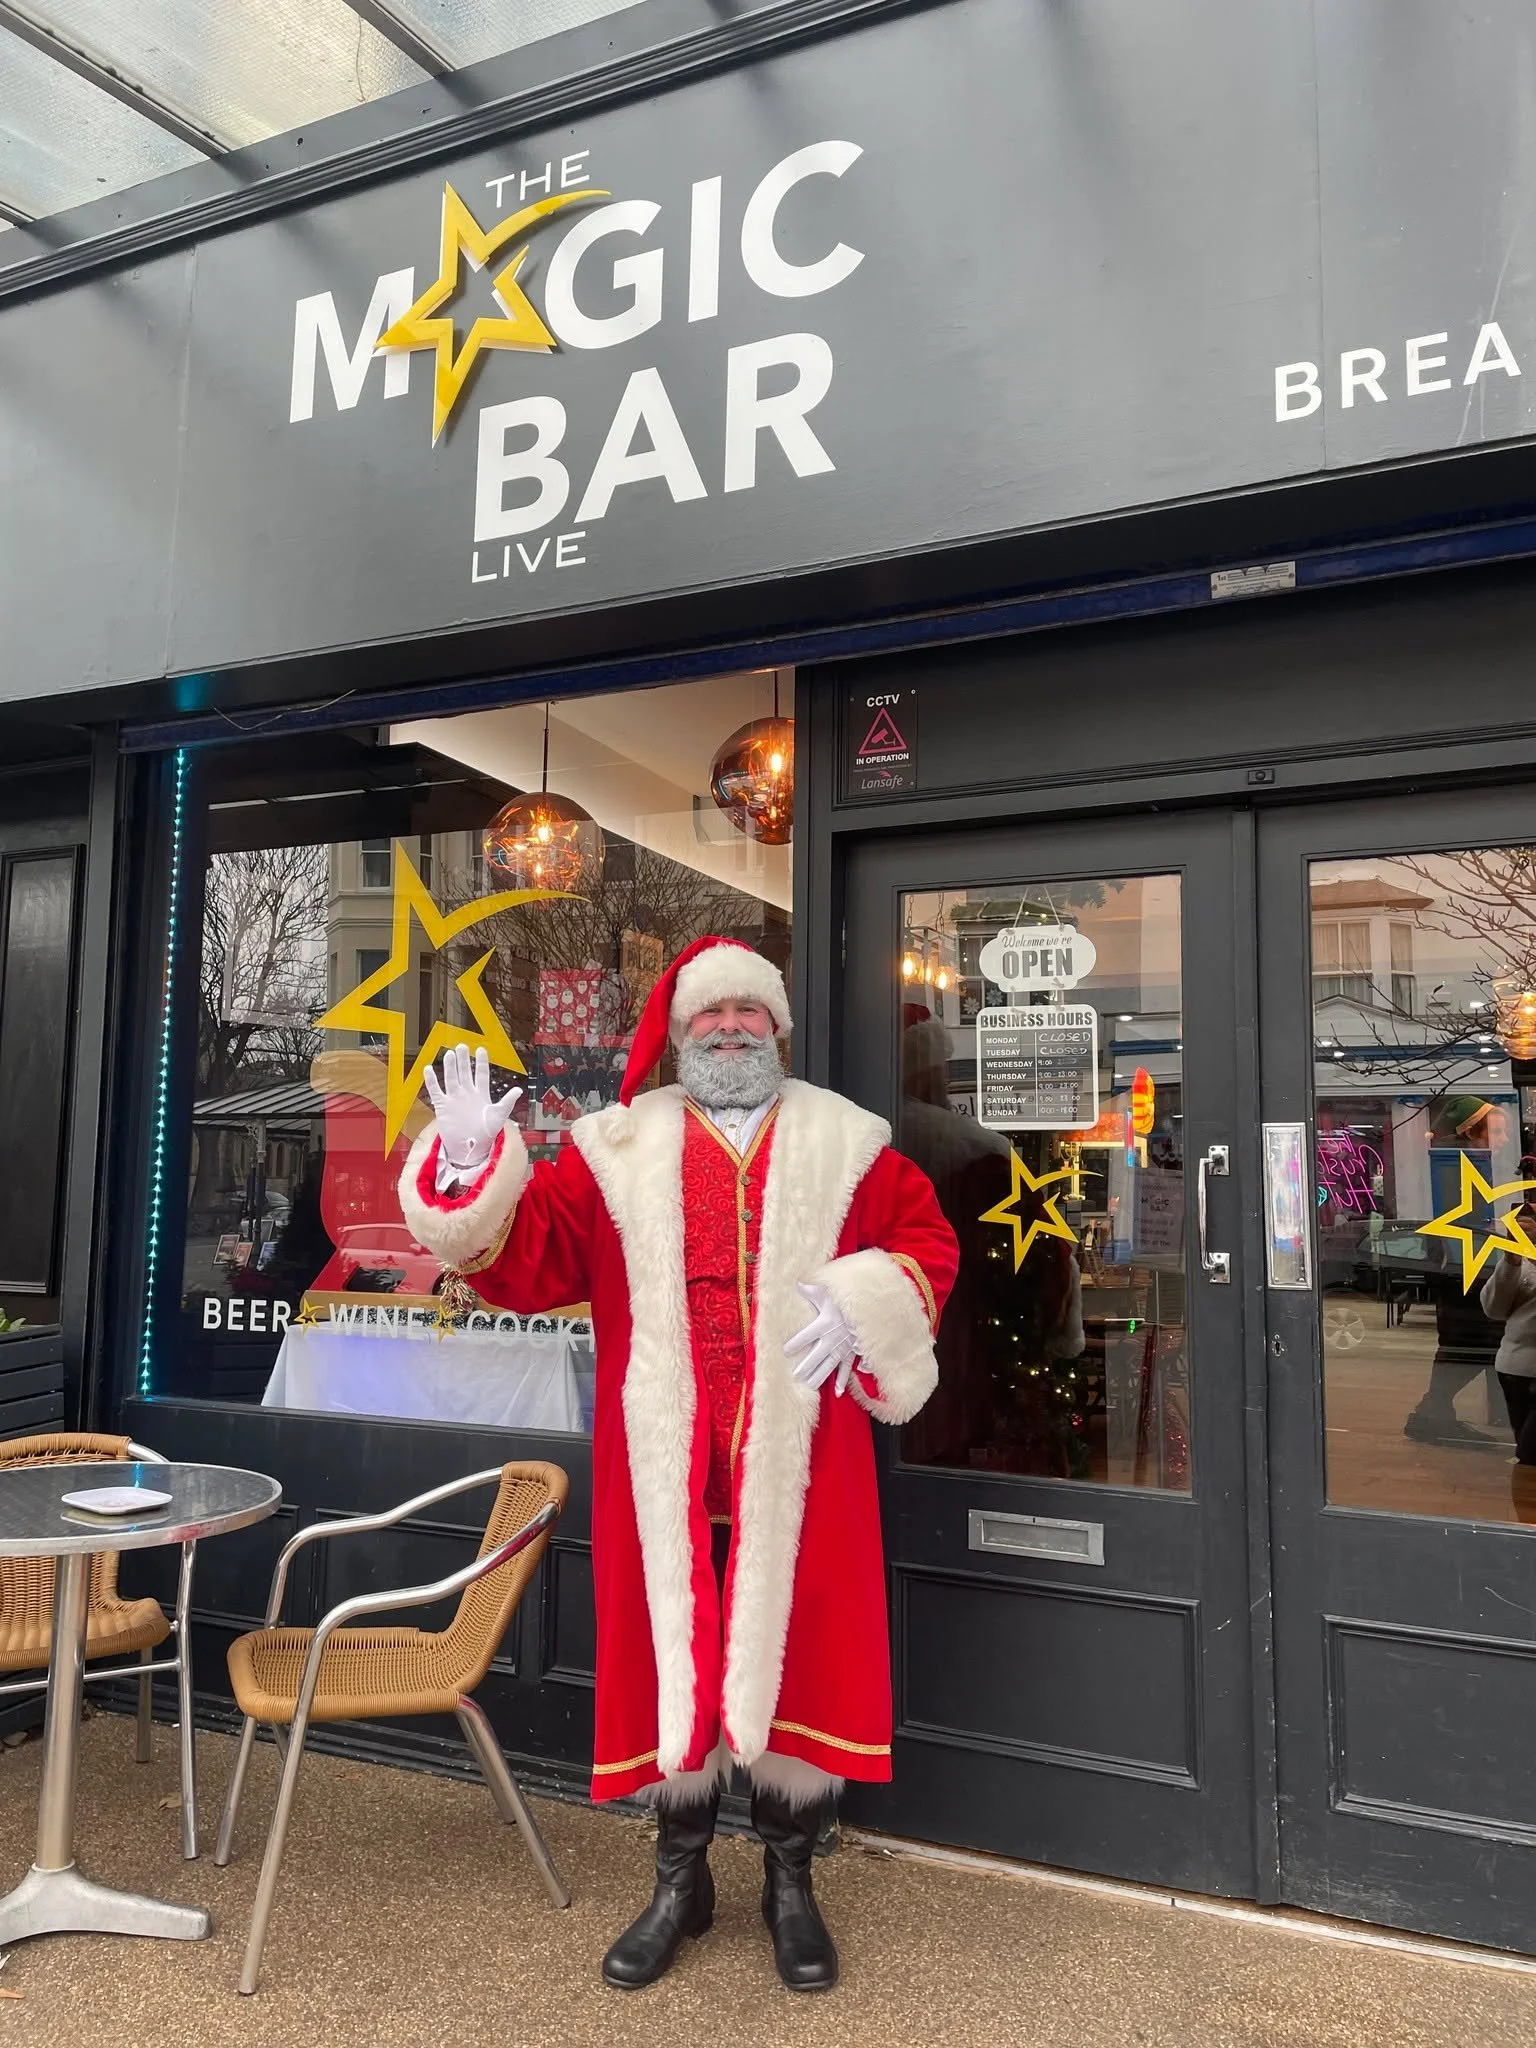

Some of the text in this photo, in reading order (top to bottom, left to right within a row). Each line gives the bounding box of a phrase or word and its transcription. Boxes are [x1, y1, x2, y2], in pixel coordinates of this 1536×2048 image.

[485, 150, 591, 208] THE
[290, 139, 865, 423] MGIC
[1275, 322, 1522, 422] BREA
[473, 333, 836, 542] BAR
[471, 531, 587, 583] LIVE
[866, 694, 900, 707] CCTV
[866, 753, 909, 764] OPERATION
[861, 775, 903, 789] Lansafe
[1002, 935, 1045, 948] Welcome
[1002, 948, 1073, 979] OPEN
[981, 1012, 1092, 1028] BUSINESS HOURS
[1039, 1032, 1091, 1042] CLOSED
[1040, 1046, 1087, 1055] CLOSED
[202, 1297, 291, 1332] BEER
[329, 1302, 427, 1341] WINE
